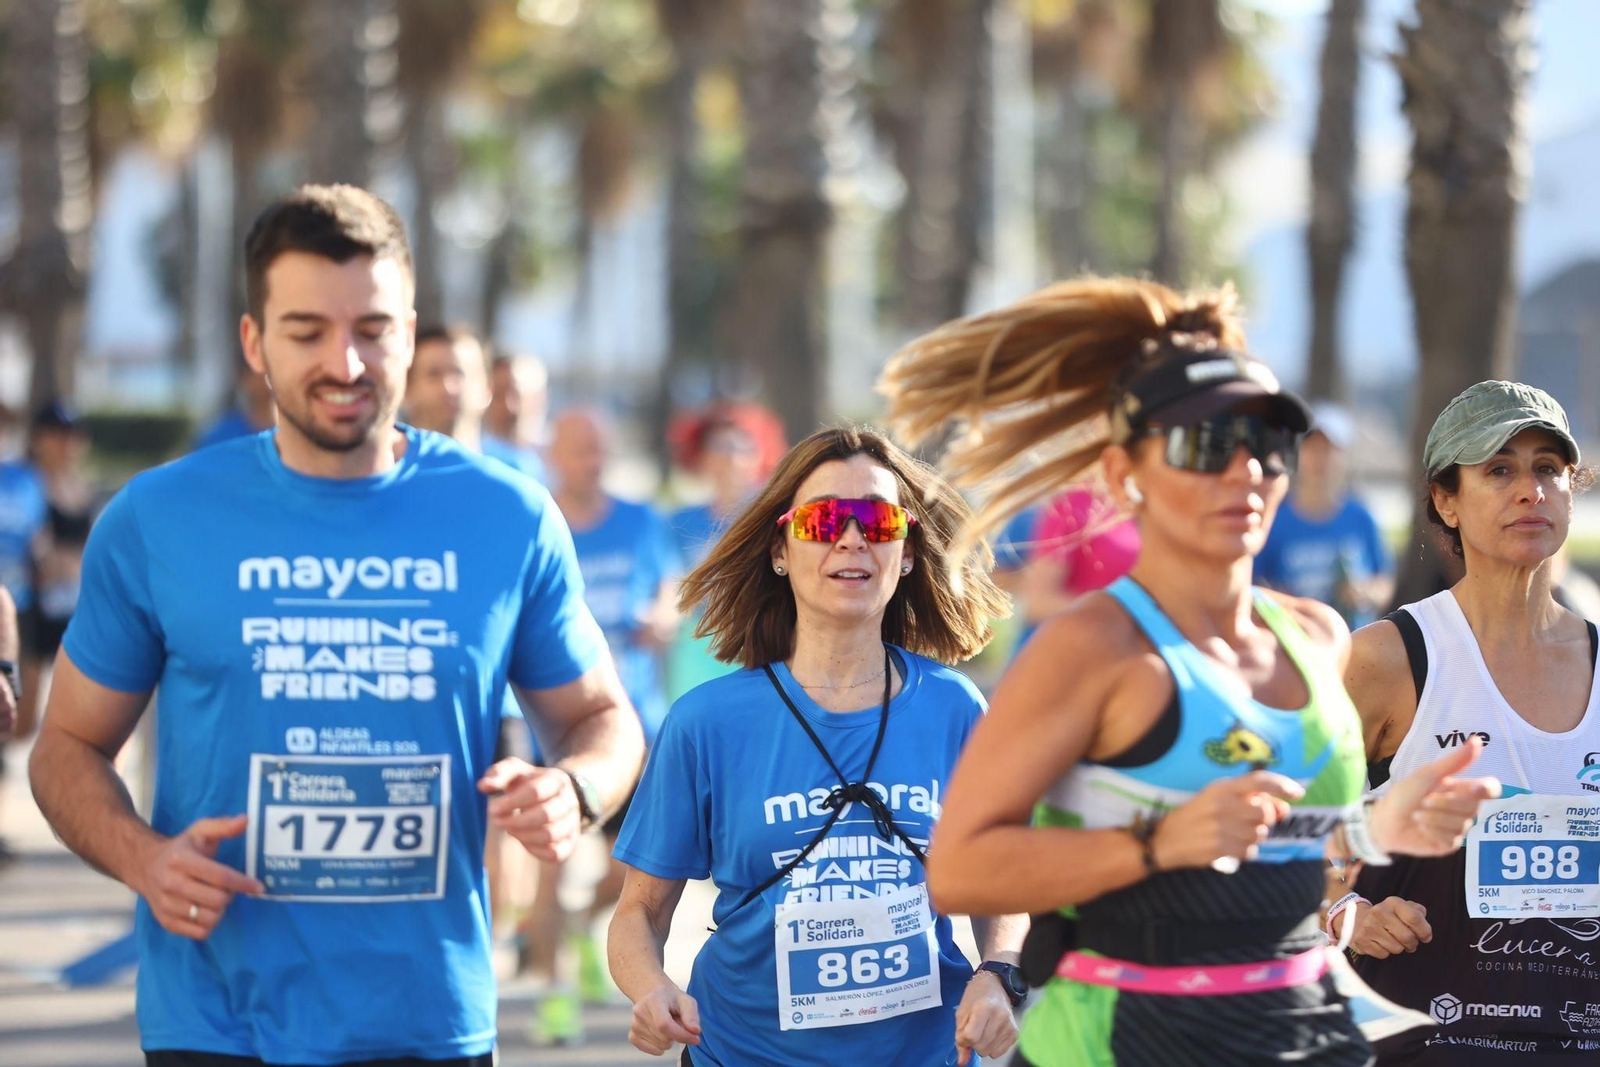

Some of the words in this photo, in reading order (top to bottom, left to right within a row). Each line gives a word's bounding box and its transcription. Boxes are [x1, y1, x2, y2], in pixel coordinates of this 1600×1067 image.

[238, 550, 459, 600] mayoral
[241, 617, 449, 646] RUNNING
[264, 644, 435, 673] MAKES
[260, 672, 437, 701] FRIENDS
[319, 727, 370, 740] ALDEAS
[319, 741, 390, 754] INFANTILES
[288, 772, 346, 789] Carrera
[288, 786, 357, 802] Solidaria
[1496, 811, 1537, 821] Carrera
[278, 814, 424, 851] 1778
[1495, 822, 1542, 833] Solidaria
[1501, 845, 1580, 880] 988
[791, 859, 911, 888] MAKES
[1478, 887, 1500, 898] 5KM
[887, 893, 922, 914] mayoral
[806, 918, 855, 930] Carrera
[807, 927, 864, 942] Solidaria
[817, 944, 909, 987] 863
[1476, 961, 1523, 971] COCINA
[791, 996, 816, 1007] 5KM
[825, 992, 861, 1002] SALMERÓN
[903, 979, 929, 990] DOLORES
[1456, 1036, 1537, 1052] MARIMARTUR
